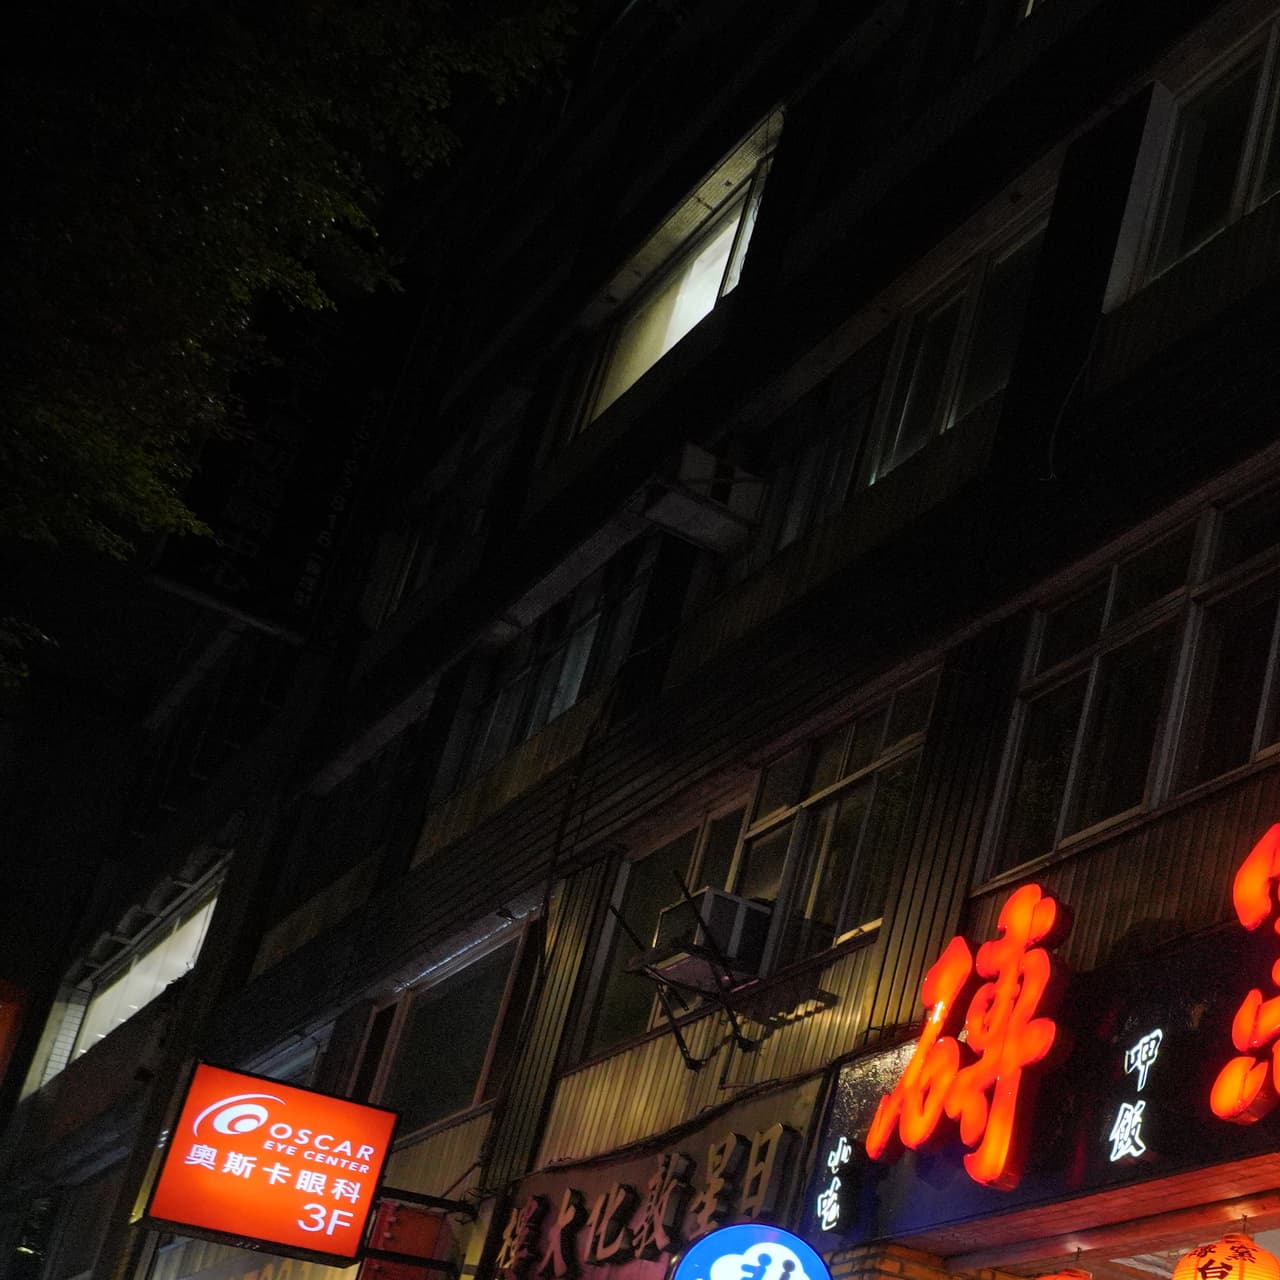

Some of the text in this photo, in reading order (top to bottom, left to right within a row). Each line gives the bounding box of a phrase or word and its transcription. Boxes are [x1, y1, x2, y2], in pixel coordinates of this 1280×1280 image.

[1108, 1028, 1163, 1162] 呷飯
[263, 1140, 370, 1174] EYE CENTER
[269, 1123, 375, 1161] OSCAR
[297, 1203, 354, 1235] 3F
